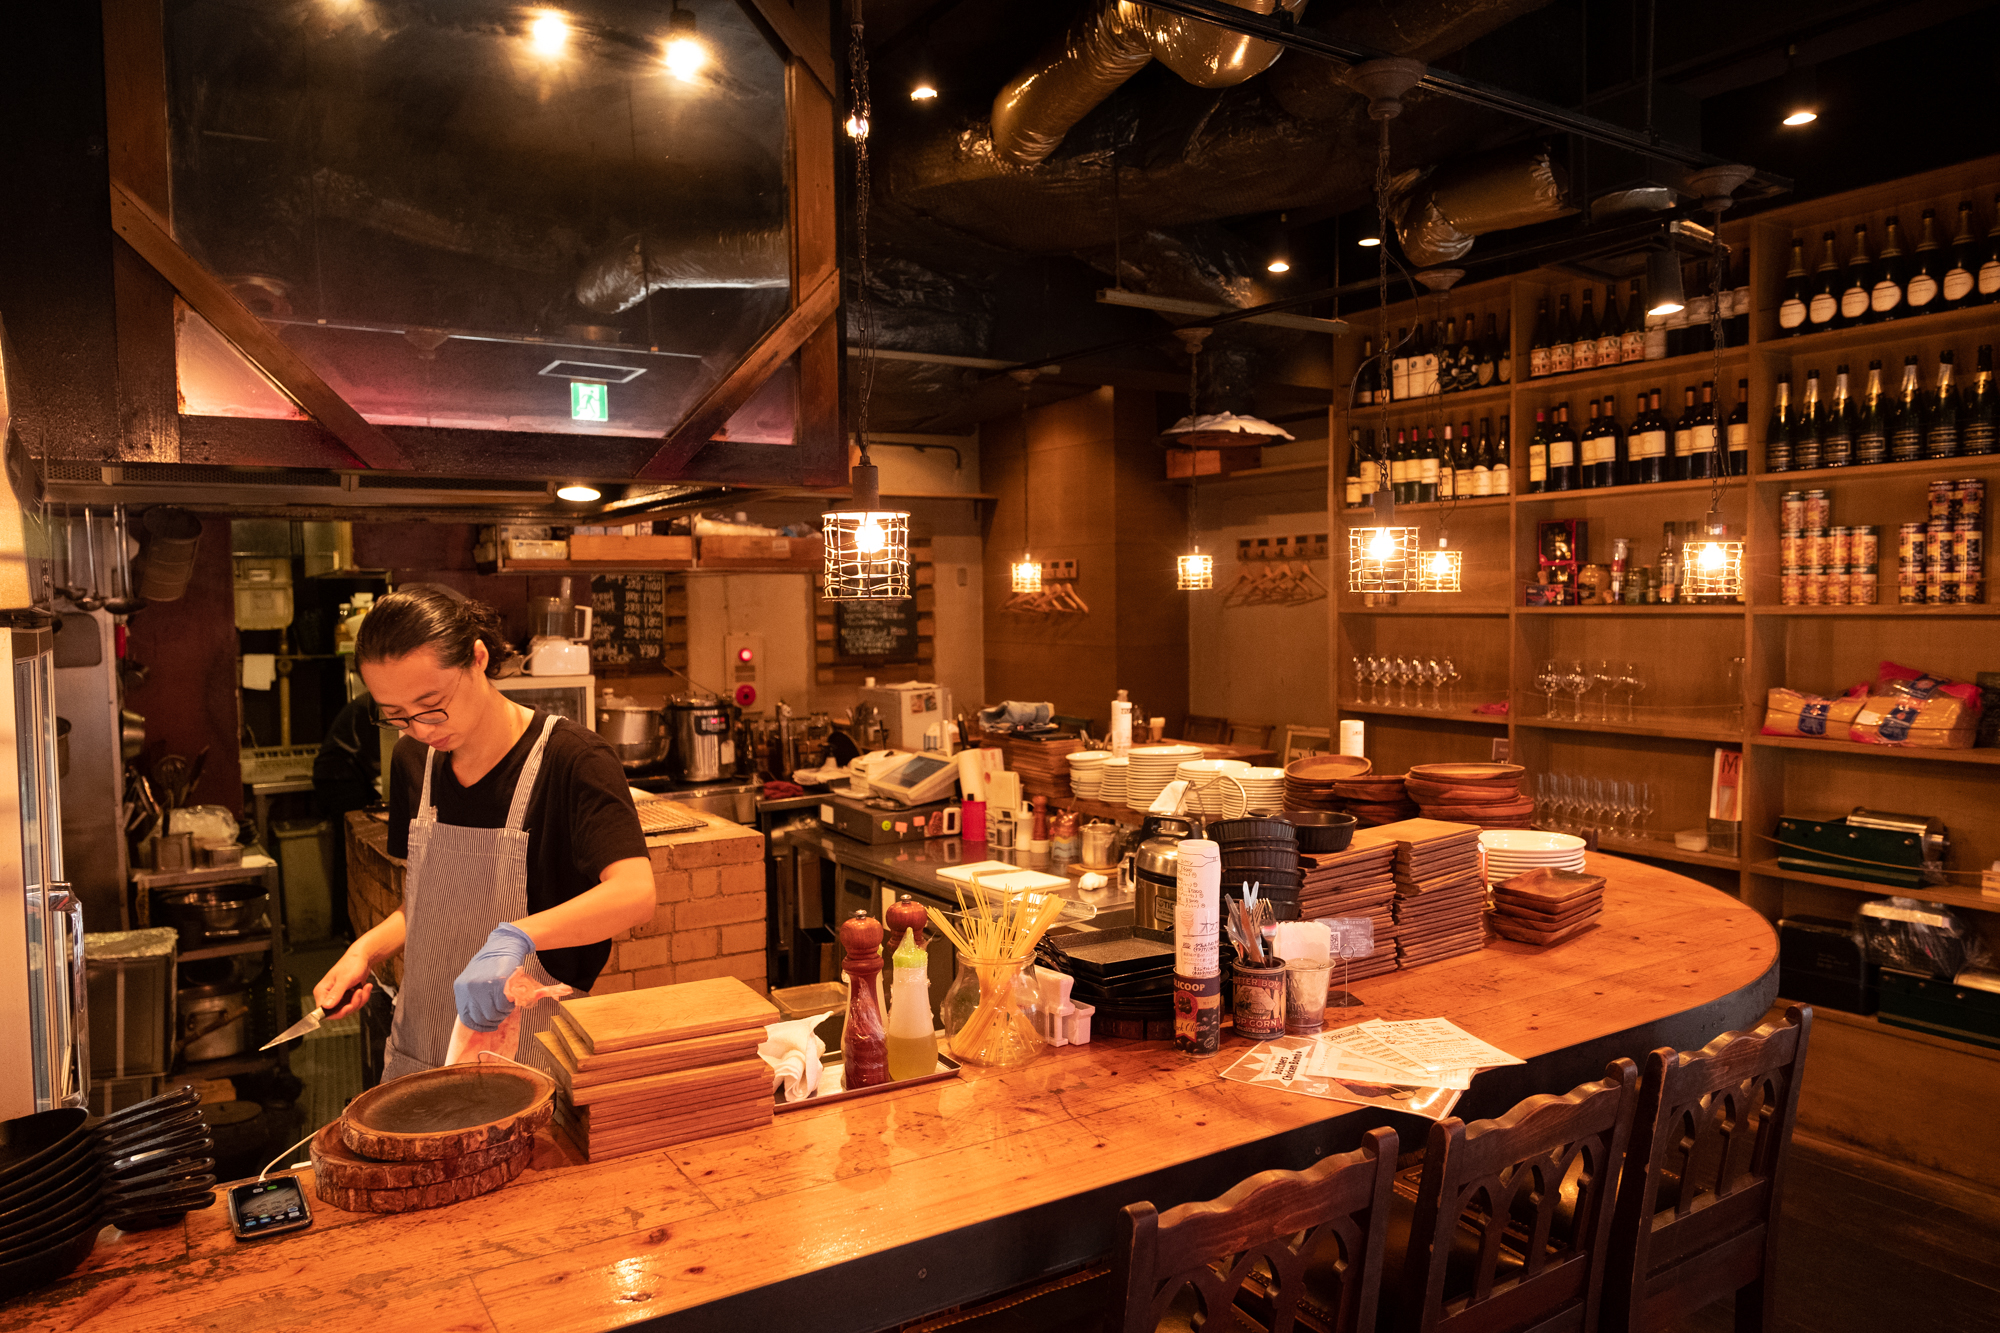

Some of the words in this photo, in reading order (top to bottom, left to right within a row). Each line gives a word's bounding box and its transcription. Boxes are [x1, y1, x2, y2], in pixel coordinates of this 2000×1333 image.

[1174, 978, 1206, 992] LICOOP
[1261, 980, 1281, 989] BOY
[1249, 1020, 1277, 1028] CORN
